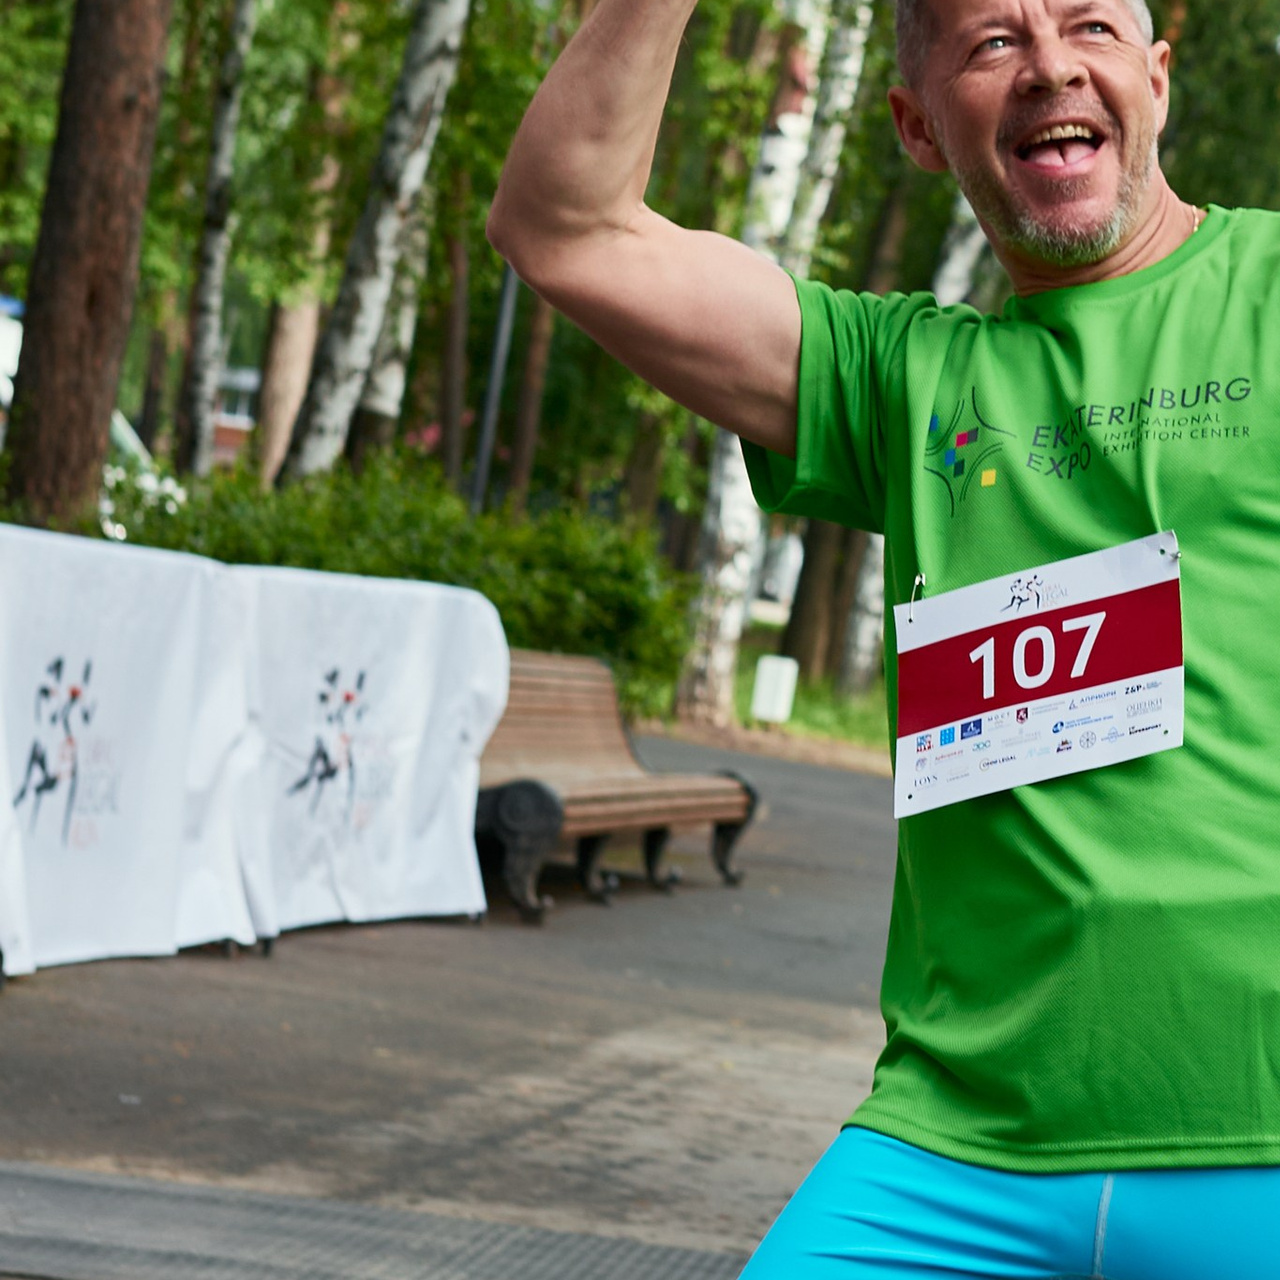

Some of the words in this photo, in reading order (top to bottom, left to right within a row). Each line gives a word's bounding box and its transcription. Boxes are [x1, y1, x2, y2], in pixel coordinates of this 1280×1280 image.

[1032, 376, 1252, 450] EKATERINBURG
[1190, 426, 1251, 440] CENTER
[1025, 443, 1092, 480] EXPO
[968, 611, 1107, 700] 107
